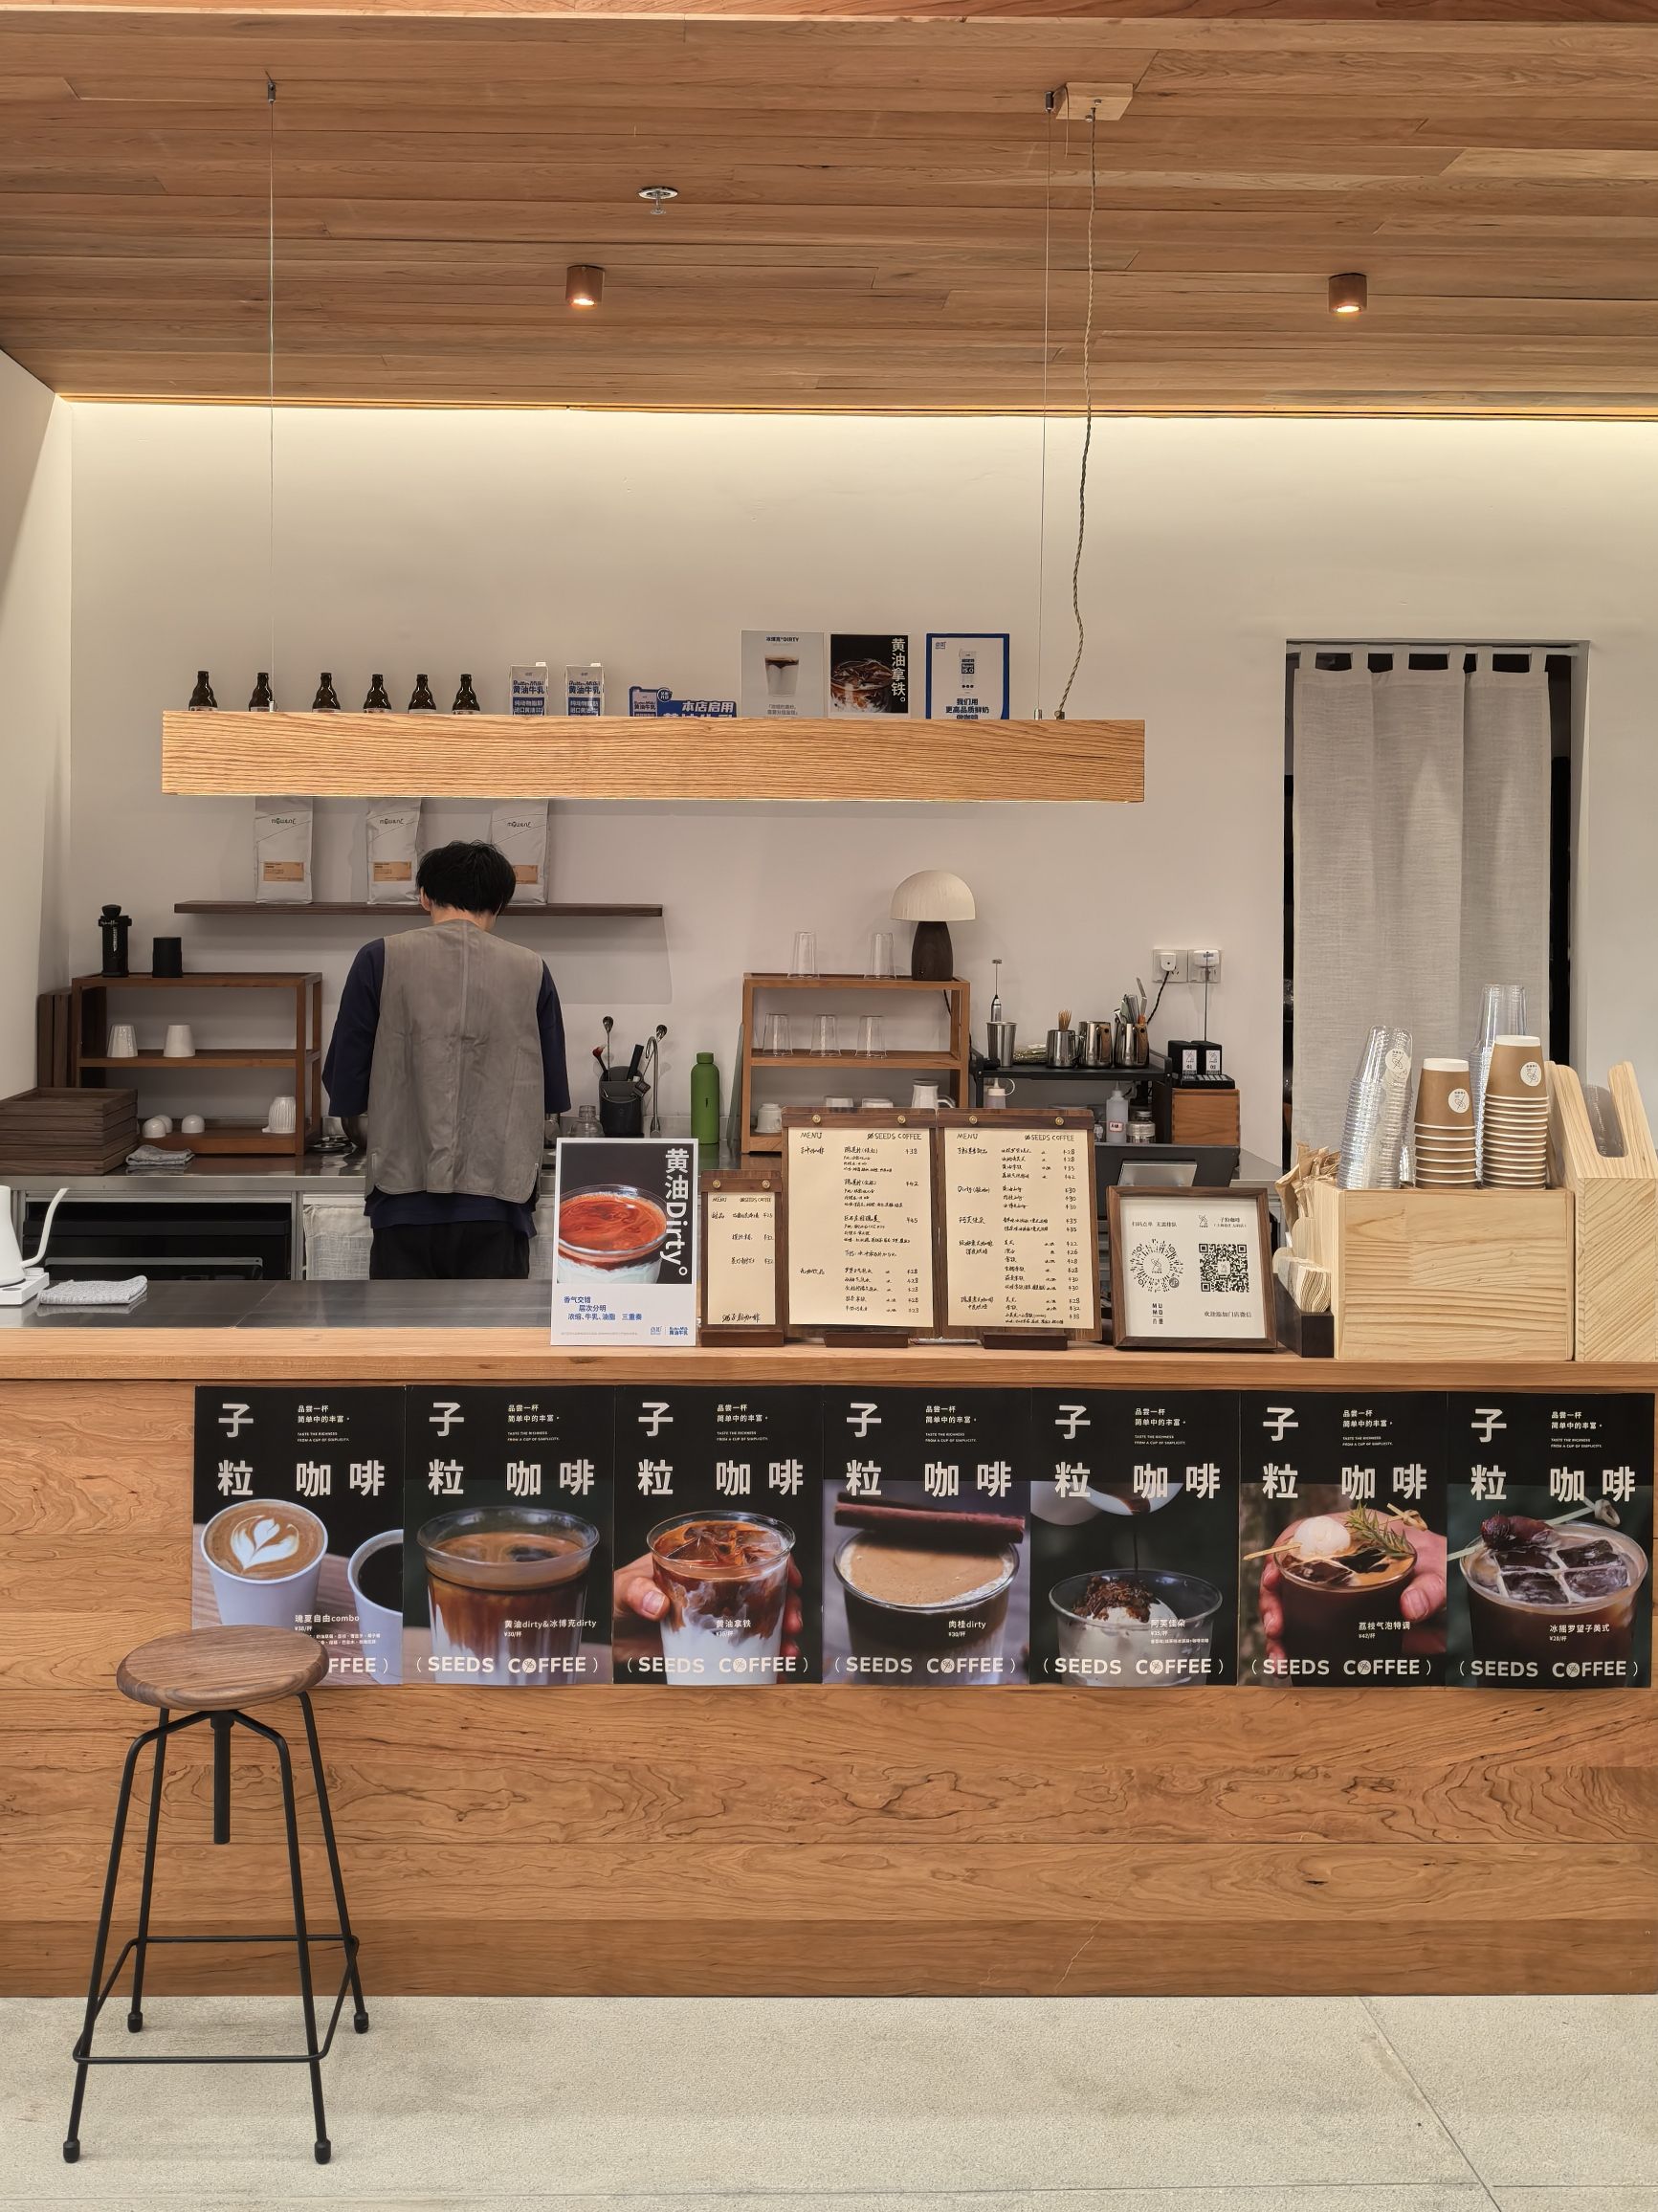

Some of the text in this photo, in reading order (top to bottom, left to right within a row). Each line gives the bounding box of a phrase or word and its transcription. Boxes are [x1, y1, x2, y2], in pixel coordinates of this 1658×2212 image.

[513, 685, 544, 694] 黄油牛乳
[682, 701, 734, 712] 本店启用
[218, 1404, 254, 1437] 子
[430, 1403, 464, 1436] 子
[638, 1403, 673, 1436] 子
[847, 1403, 881, 1437] 子
[1055, 1405, 1091, 1439] 子
[1263, 1407, 1298, 1441] 子
[1471, 1408, 1507, 1442] 子
[716, 1619, 751, 1628] 黄油拿铁
[948, 1620, 986, 1629] 肉桂dirty
[1150, 1619, 1185, 1628] 阿芙佳朵
[1359, 1622, 1411, 1630] 荔枝气泡特调
